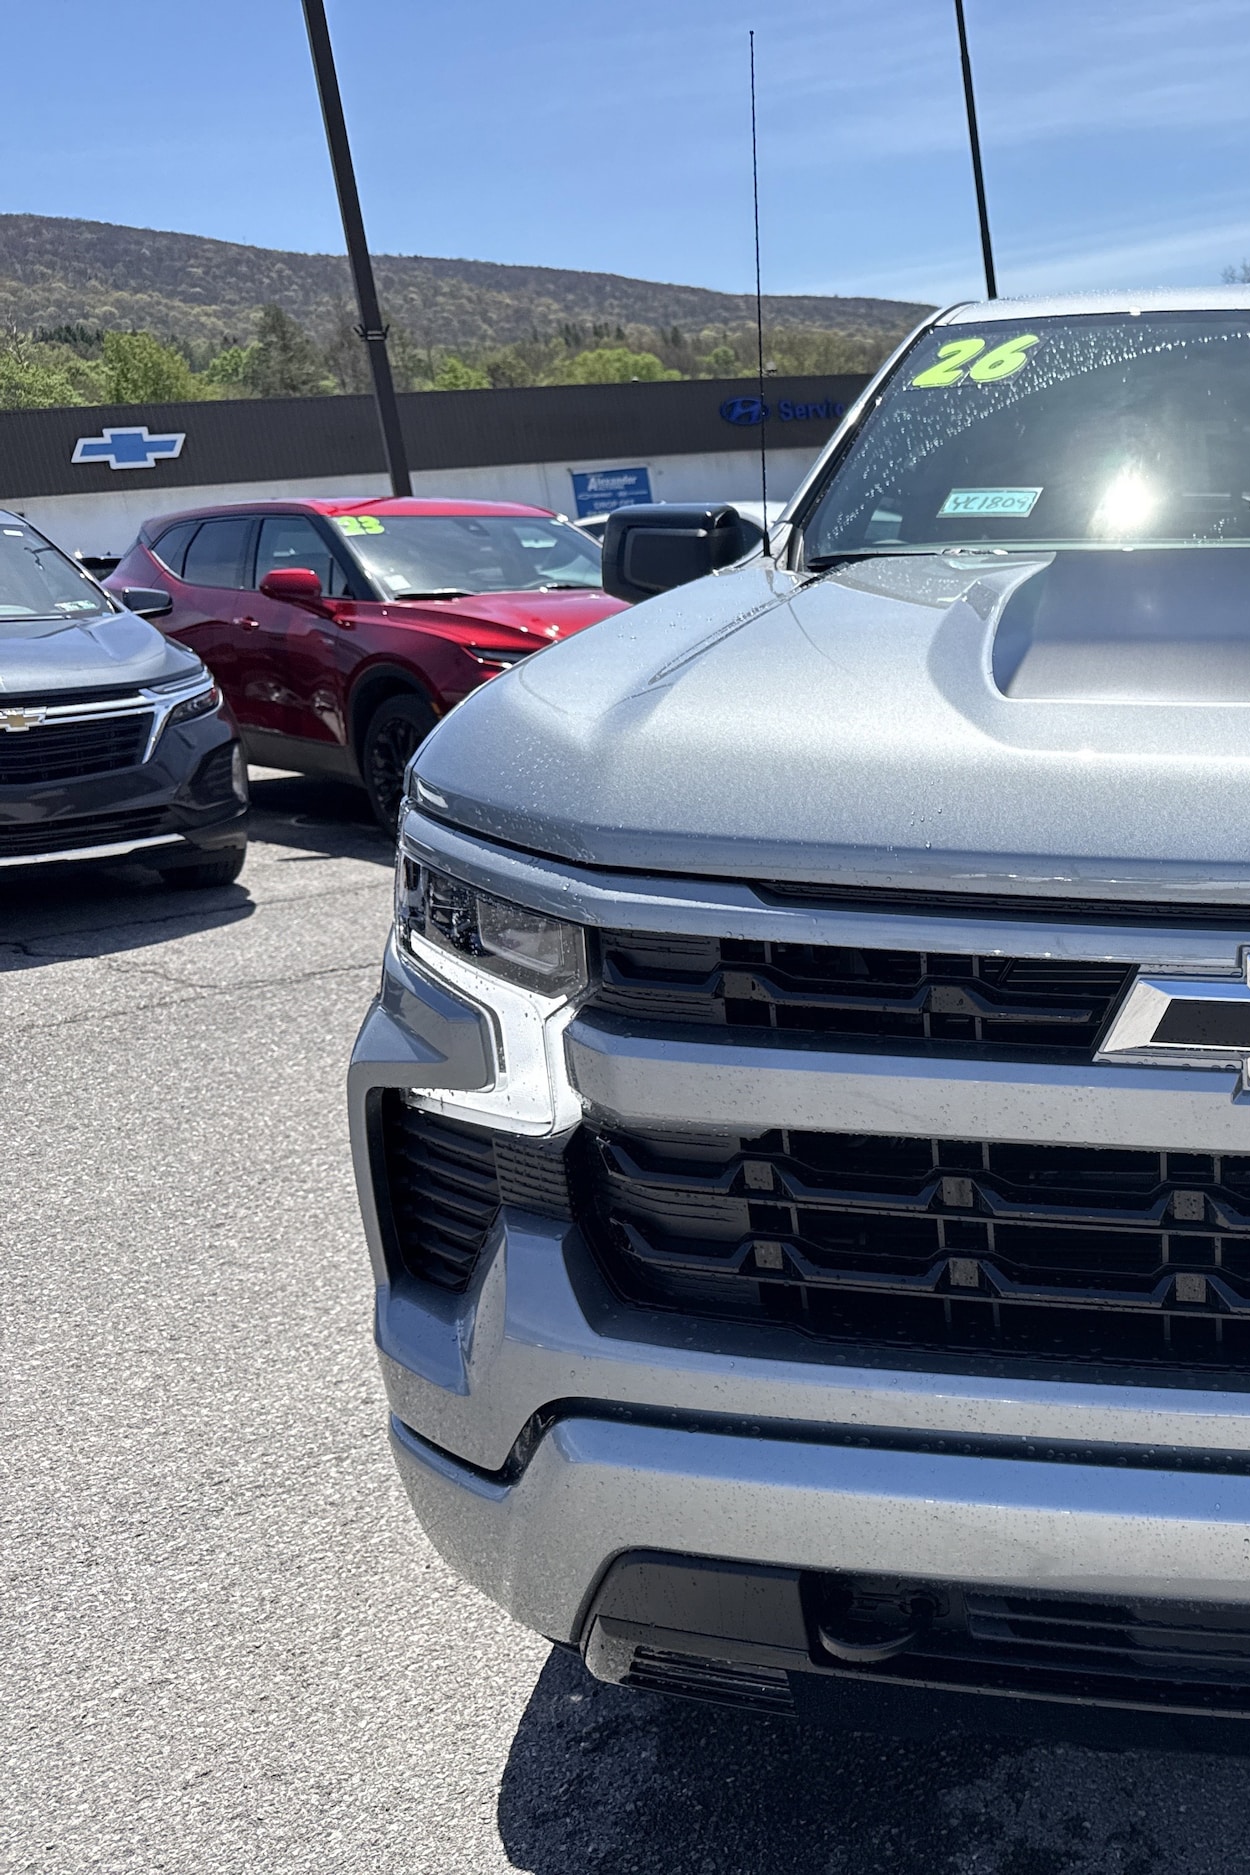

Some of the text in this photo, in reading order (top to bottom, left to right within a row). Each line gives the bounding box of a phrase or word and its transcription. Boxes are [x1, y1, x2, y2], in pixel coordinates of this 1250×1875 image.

[912, 335, 1040, 388] 26
[779, 398, 847, 421] Servic
[337, 515, 385, 537] 23
